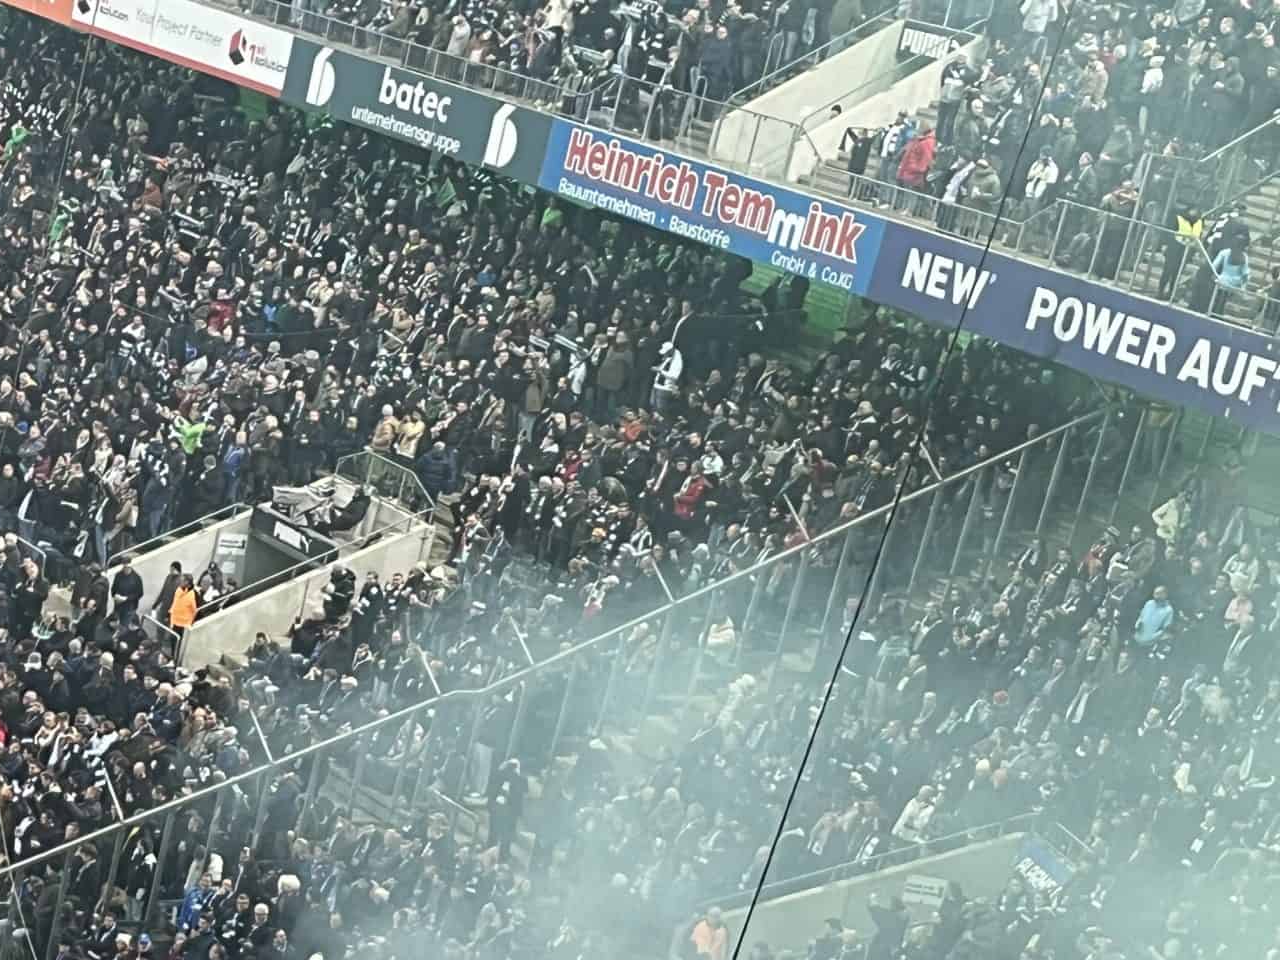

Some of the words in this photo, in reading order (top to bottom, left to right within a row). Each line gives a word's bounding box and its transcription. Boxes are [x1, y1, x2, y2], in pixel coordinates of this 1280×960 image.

[378, 66, 452, 123] batec
[351, 105, 461, 155] unternehmensgruppe
[557, 177, 657, 226] Bauunternehmen
[668, 215, 731, 249] Baustoffe
[564, 128, 698, 211] Heinrich
[701, 169, 867, 265] Temmink
[771, 249, 806, 275] GmbH
[807, 264, 817, 279] &
[1024, 286, 1177, 375] POWER
[1176, 339, 1280, 413] AUF
